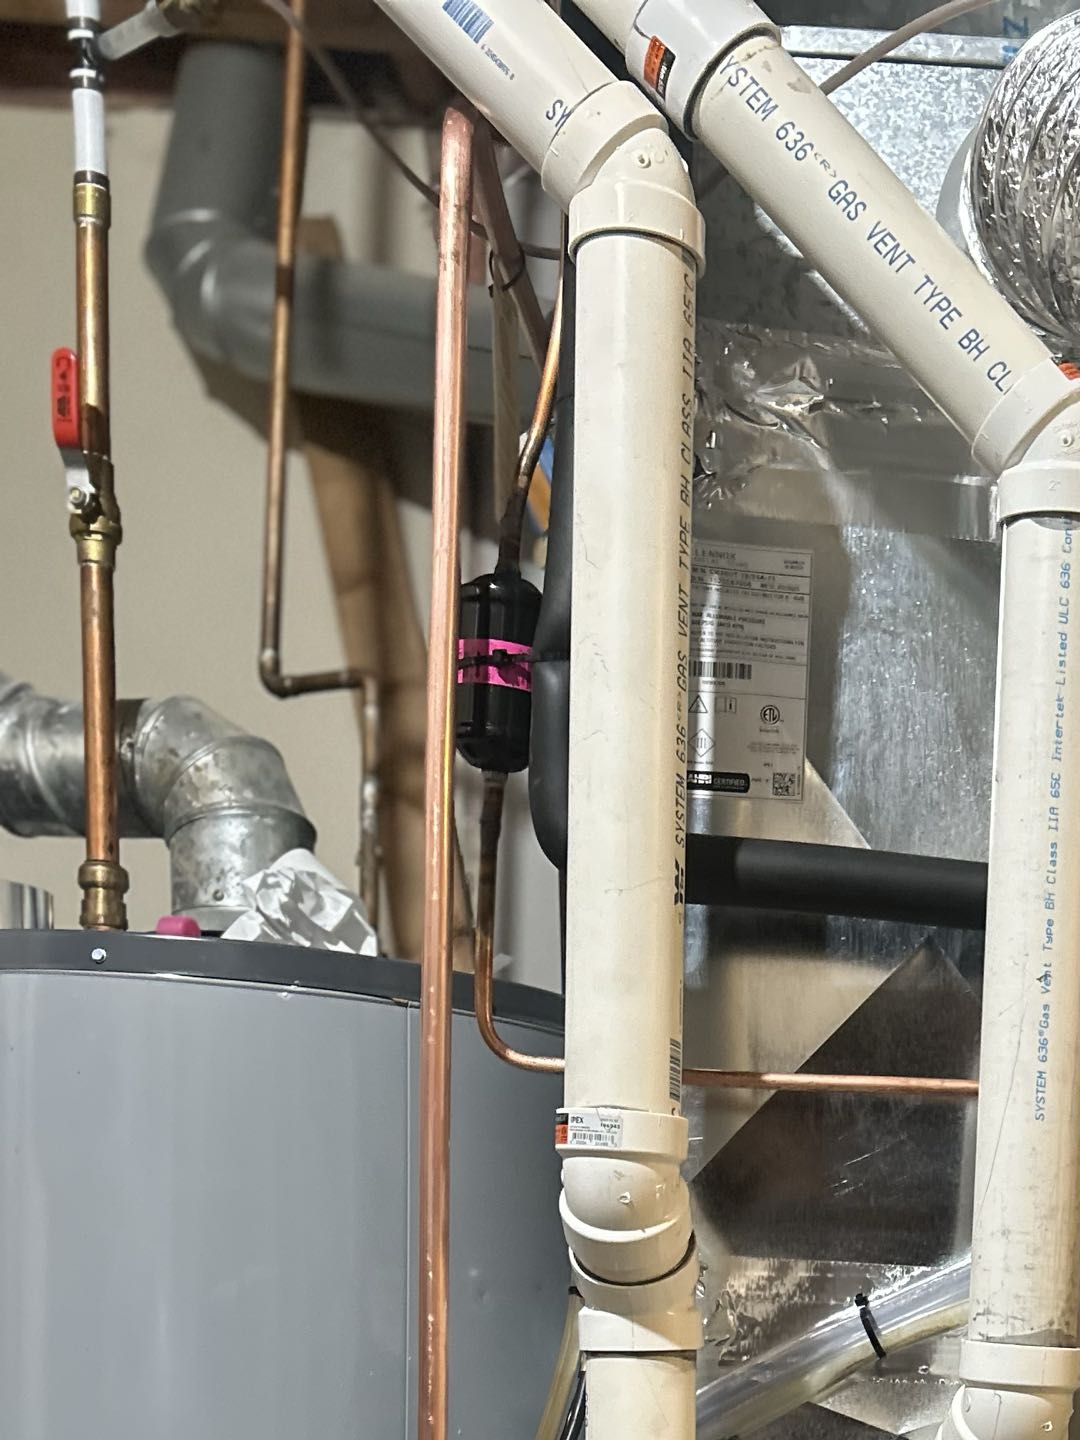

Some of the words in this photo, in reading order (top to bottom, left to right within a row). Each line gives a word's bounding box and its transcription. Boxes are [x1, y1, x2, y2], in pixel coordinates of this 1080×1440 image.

[719, 56, 779, 122] YSTEM
[827, 179, 868, 222] GAS
[866, 219, 916, 274] VENT
[913, 274, 962, 330] TYPE
[957, 328, 990, 363] BH
[678, 516, 691, 570] TYPE
[1060, 561, 1072, 590] 636
[678, 583, 690, 638] VENT
[1057, 596, 1070, 625] ULC
[676, 649, 689, 692] GAS
[674, 772, 687, 849] SYSTEM
[1046, 841, 1058, 886] Class
[1044, 889, 1055, 911] BH
[1042, 917, 1055, 953] Type
[1040, 962, 1052, 995] Vent
[1039, 1003, 1050, 1030] Gas
[1035, 1069, 1048, 1122] SYSTEM
